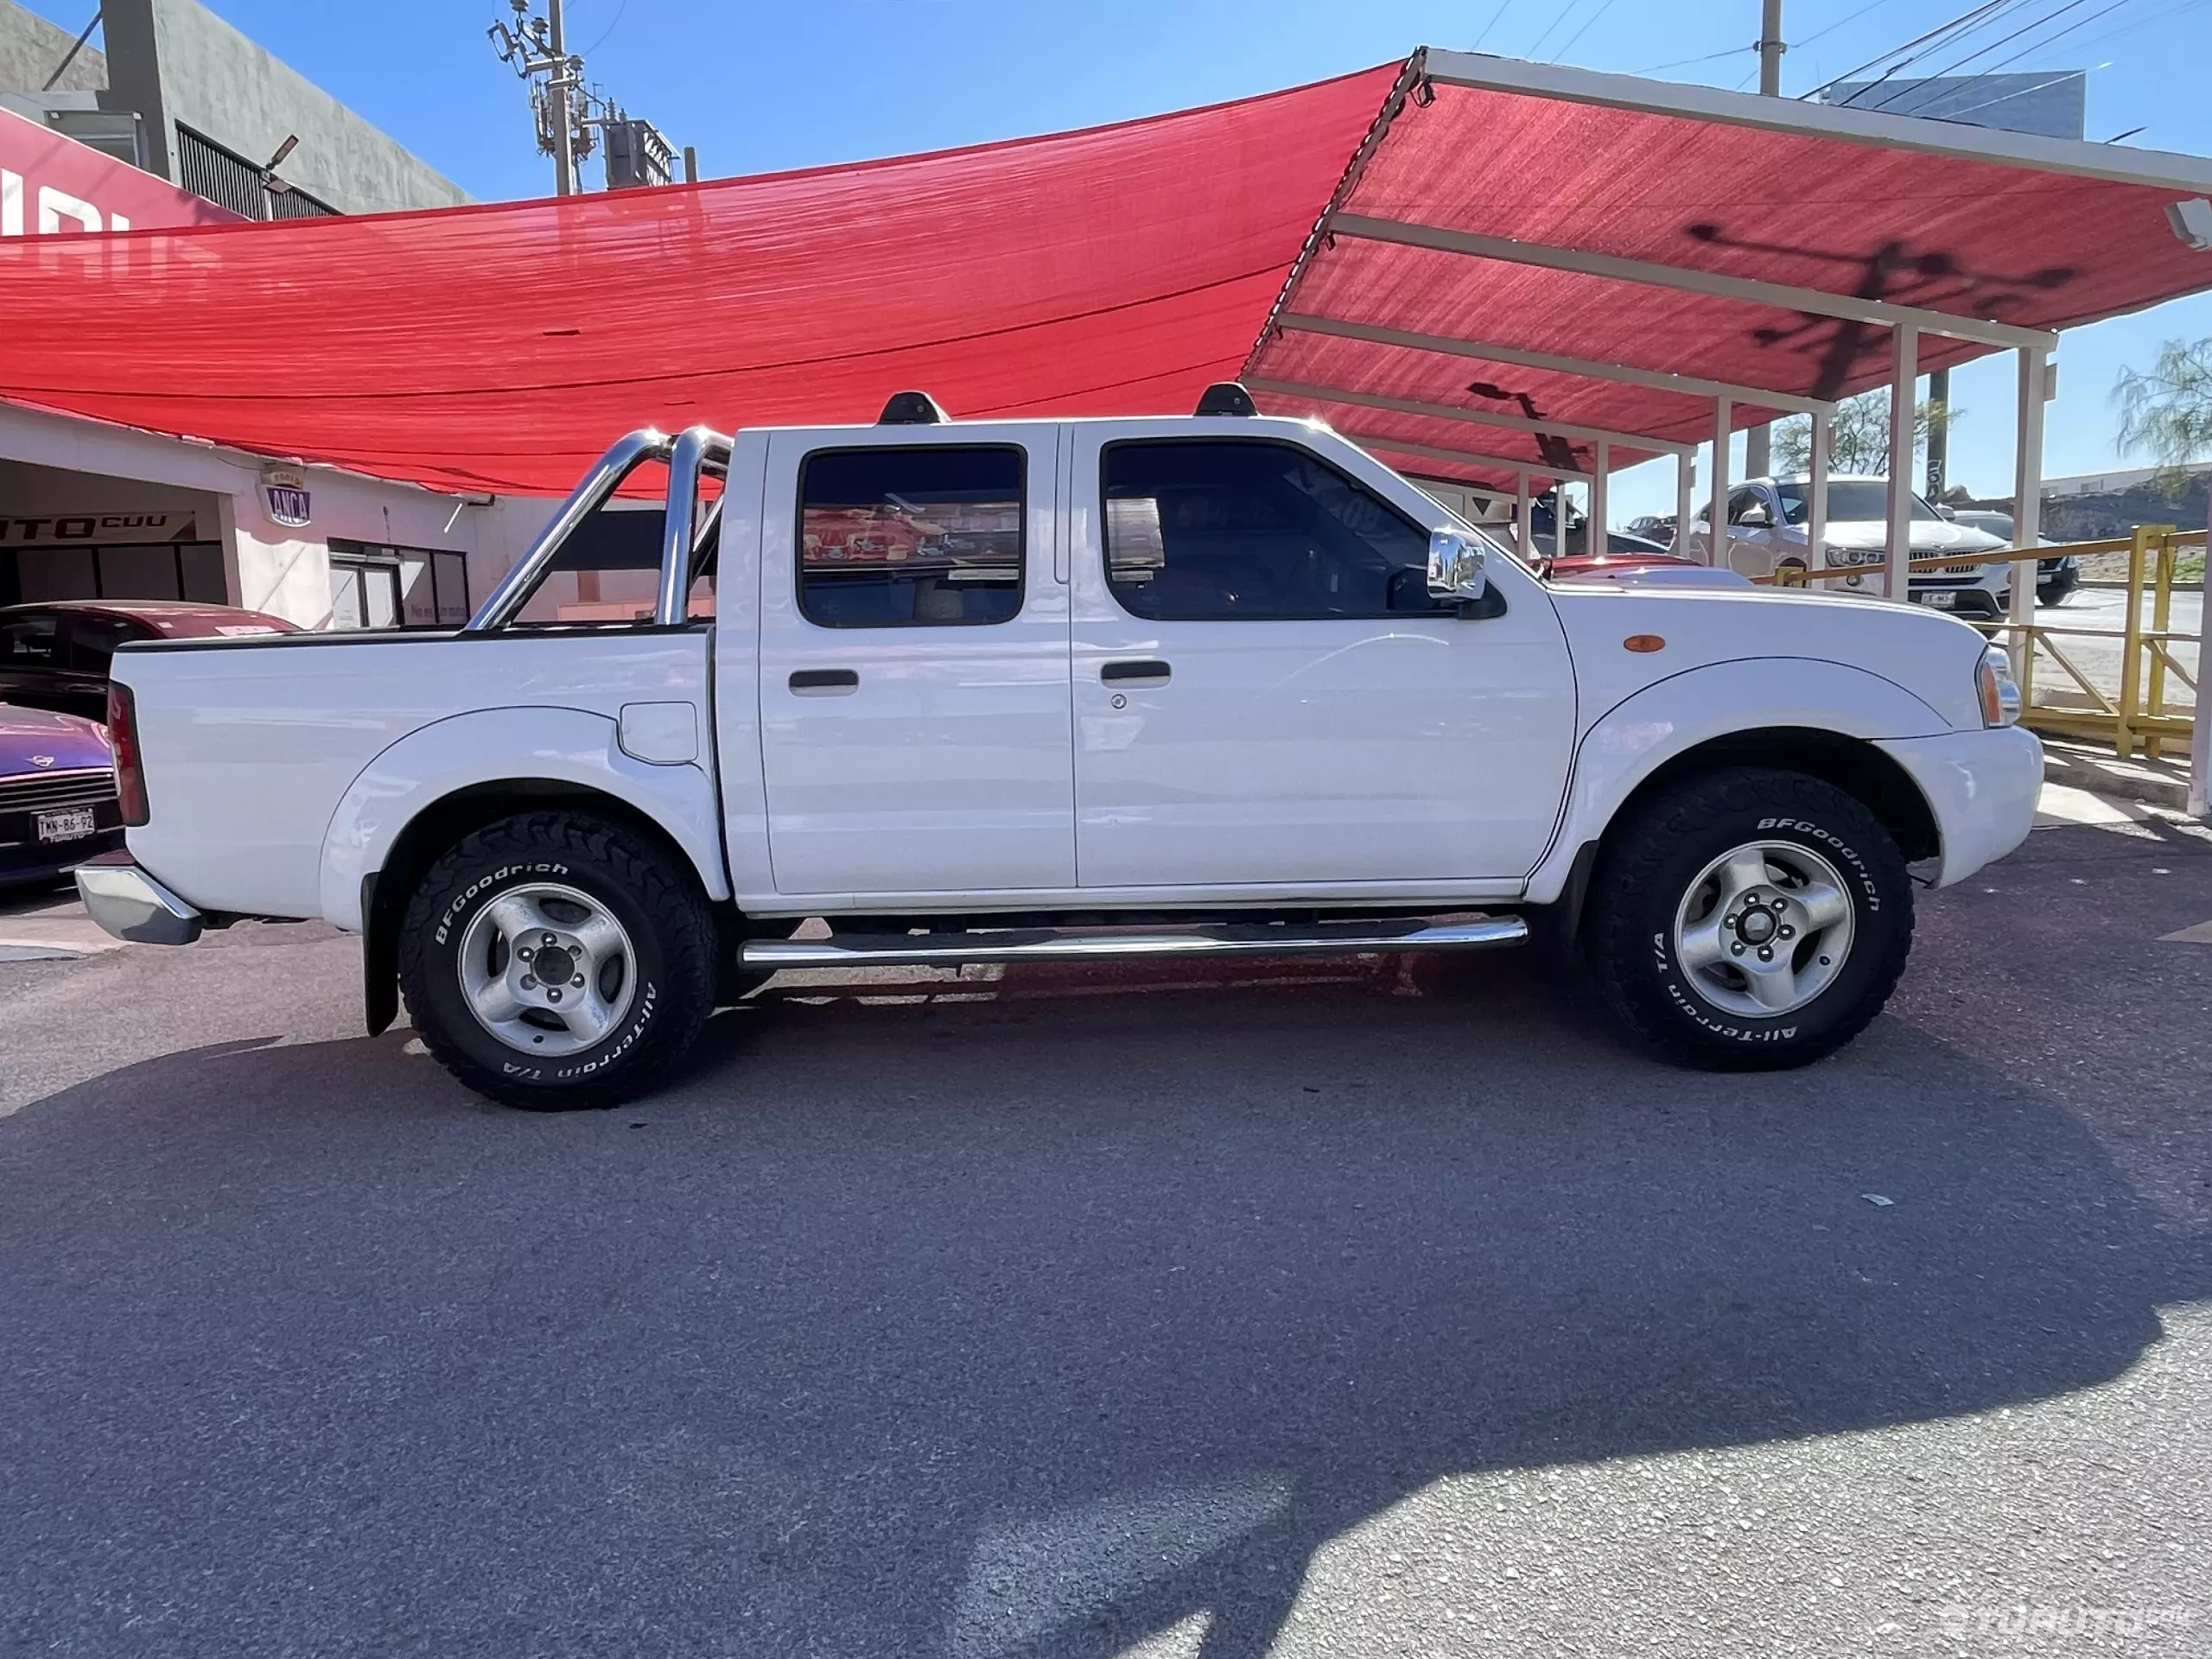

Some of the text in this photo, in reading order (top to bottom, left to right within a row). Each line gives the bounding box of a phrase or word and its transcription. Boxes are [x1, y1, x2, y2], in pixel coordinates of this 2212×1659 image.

[0, 515, 167, 540] TO CUU
[273, 489, 308, 521] ANCA
[435, 863, 569, 945] BFGoodrich
[1757, 818, 1881, 912] BFGoodrich
[503, 981, 657, 1080] All-Terrain T/A
[1653, 932, 1798, 1042] All-Terrain T/A
